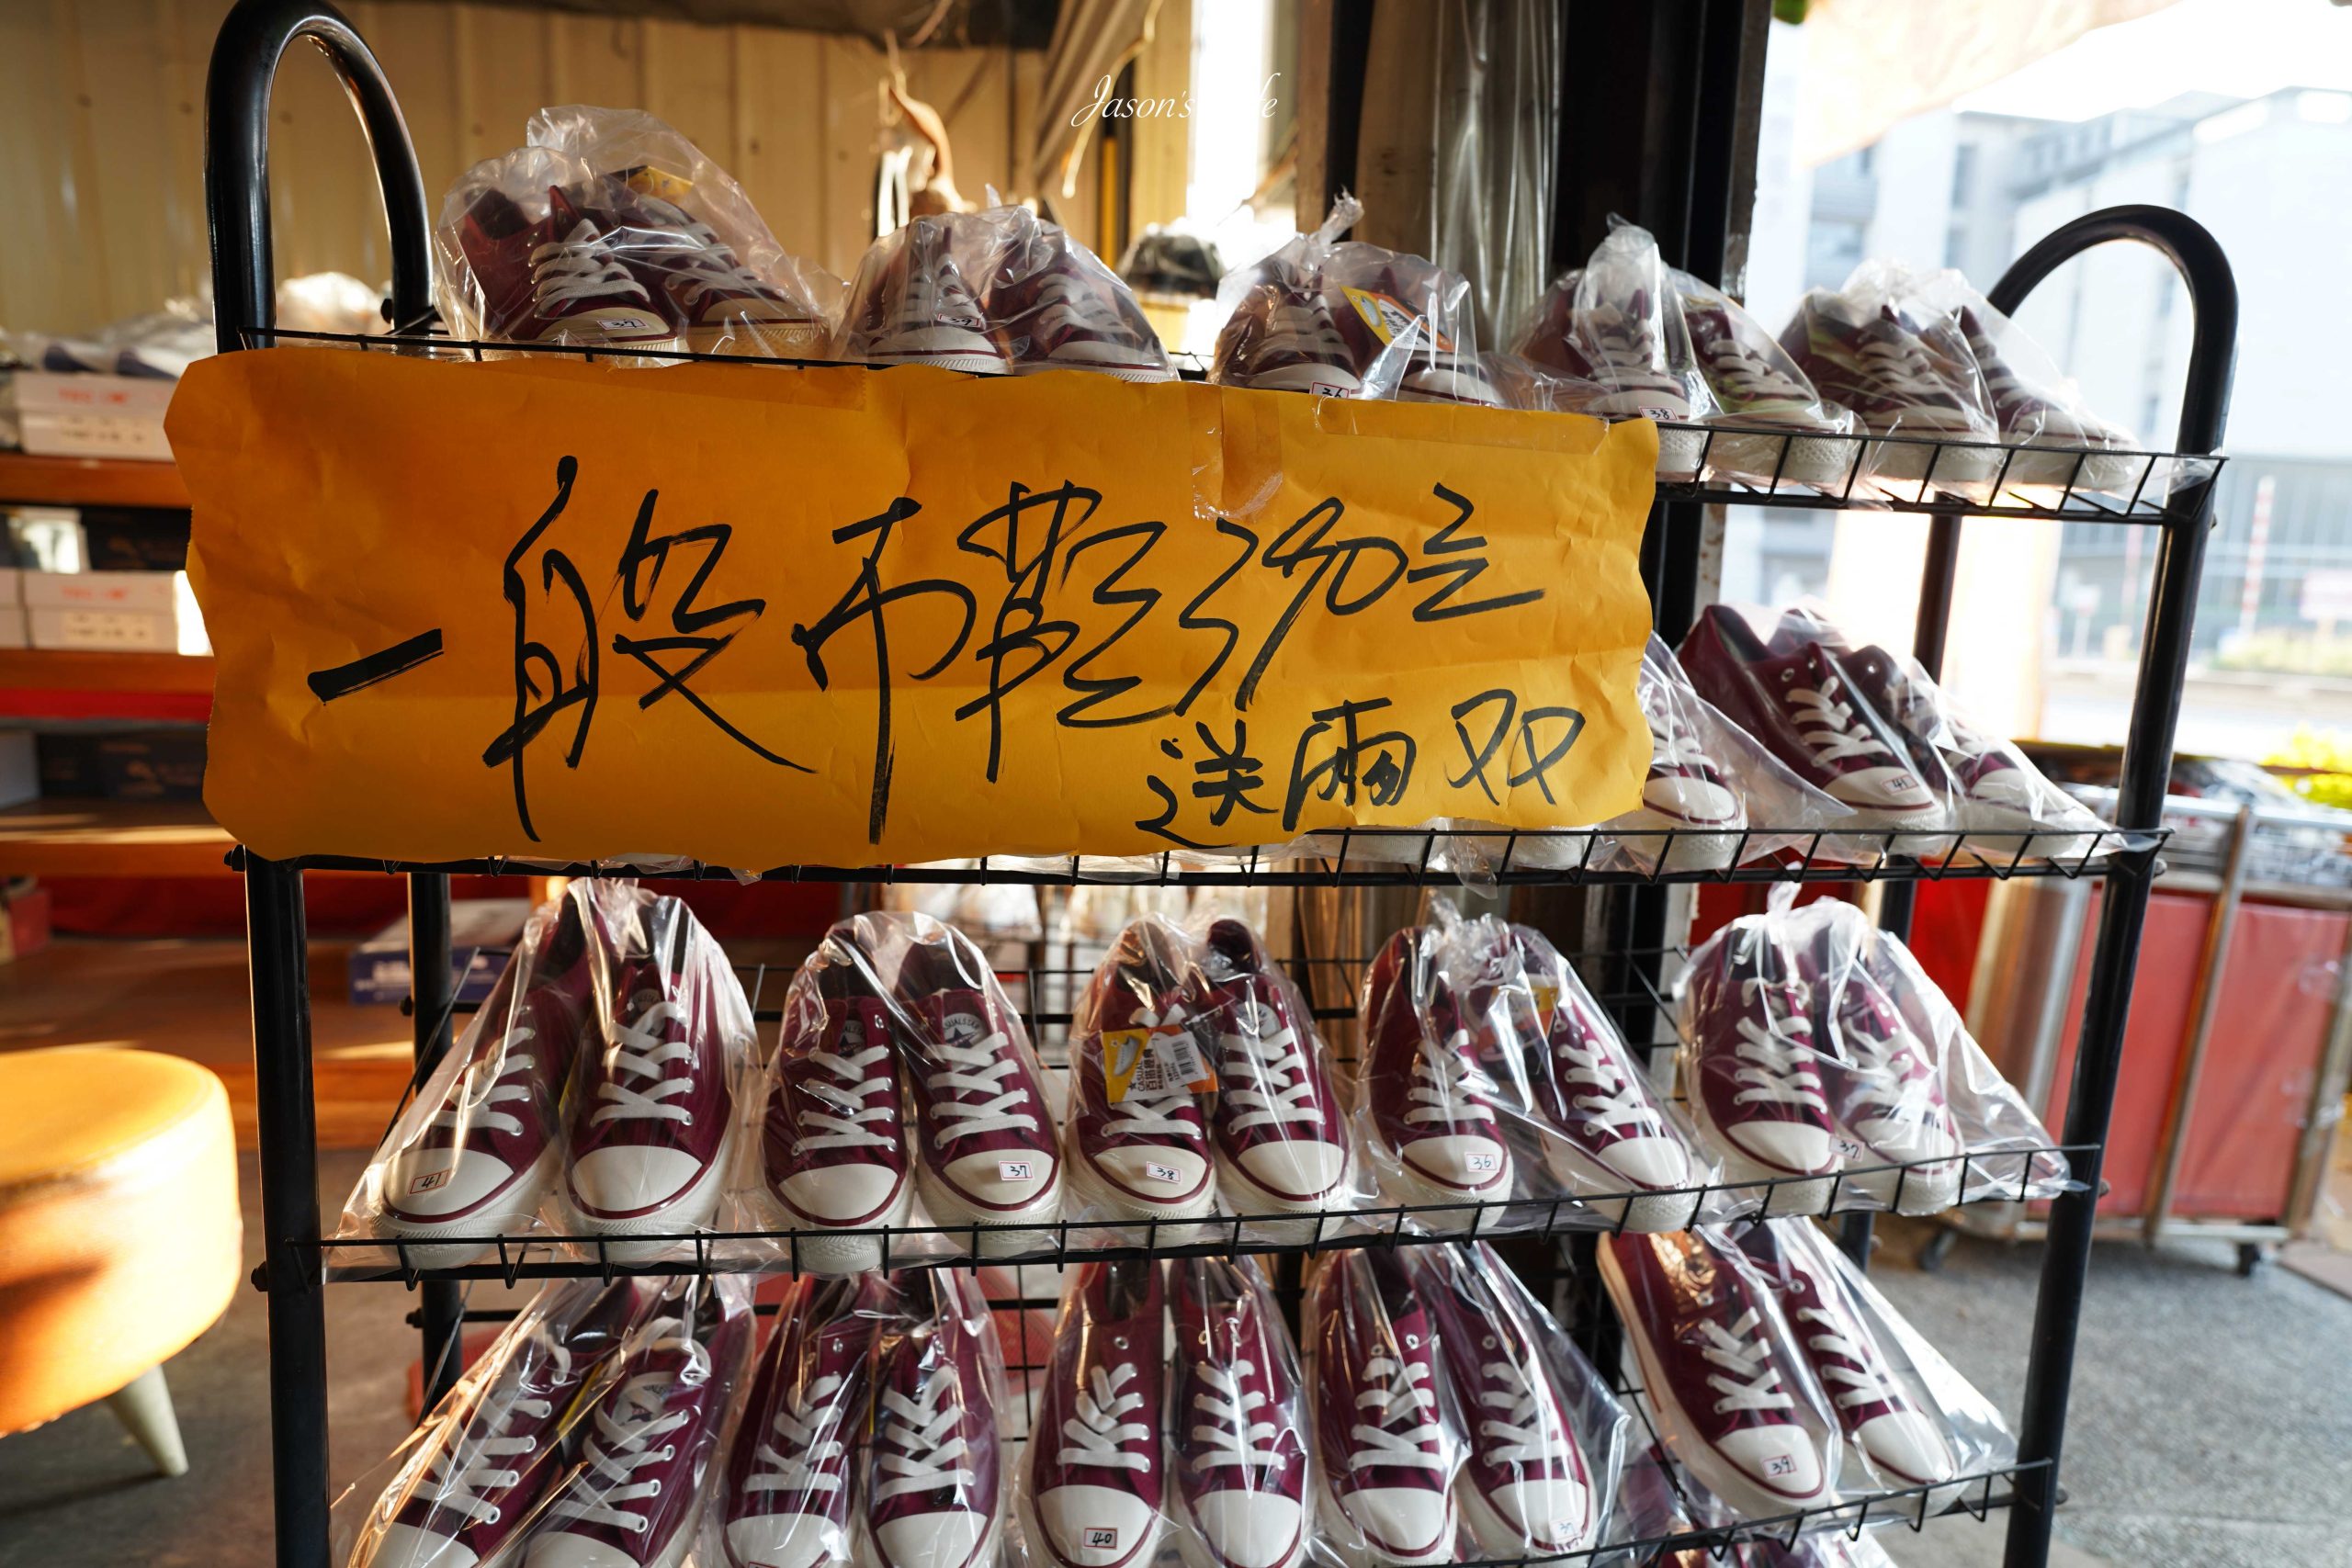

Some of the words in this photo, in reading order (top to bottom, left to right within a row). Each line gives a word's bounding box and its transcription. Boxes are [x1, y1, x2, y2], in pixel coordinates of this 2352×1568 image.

[611, 319, 638, 328] 37
[1649, 408, 1670, 421] 38
[1891, 778, 1909, 790] 41
[1136, 1061, 1146, 1092] CASUAL
[1839, 1139, 1860, 1159] 37
[1472, 1154, 1493, 1170] 36
[1009, 1165, 1028, 1179] 37
[1156, 1167, 1175, 1180] 38
[421, 1172, 442, 1189] 41
[1770, 1455, 1792, 1474] 39
[1091, 1531, 1114, 1547] 40
